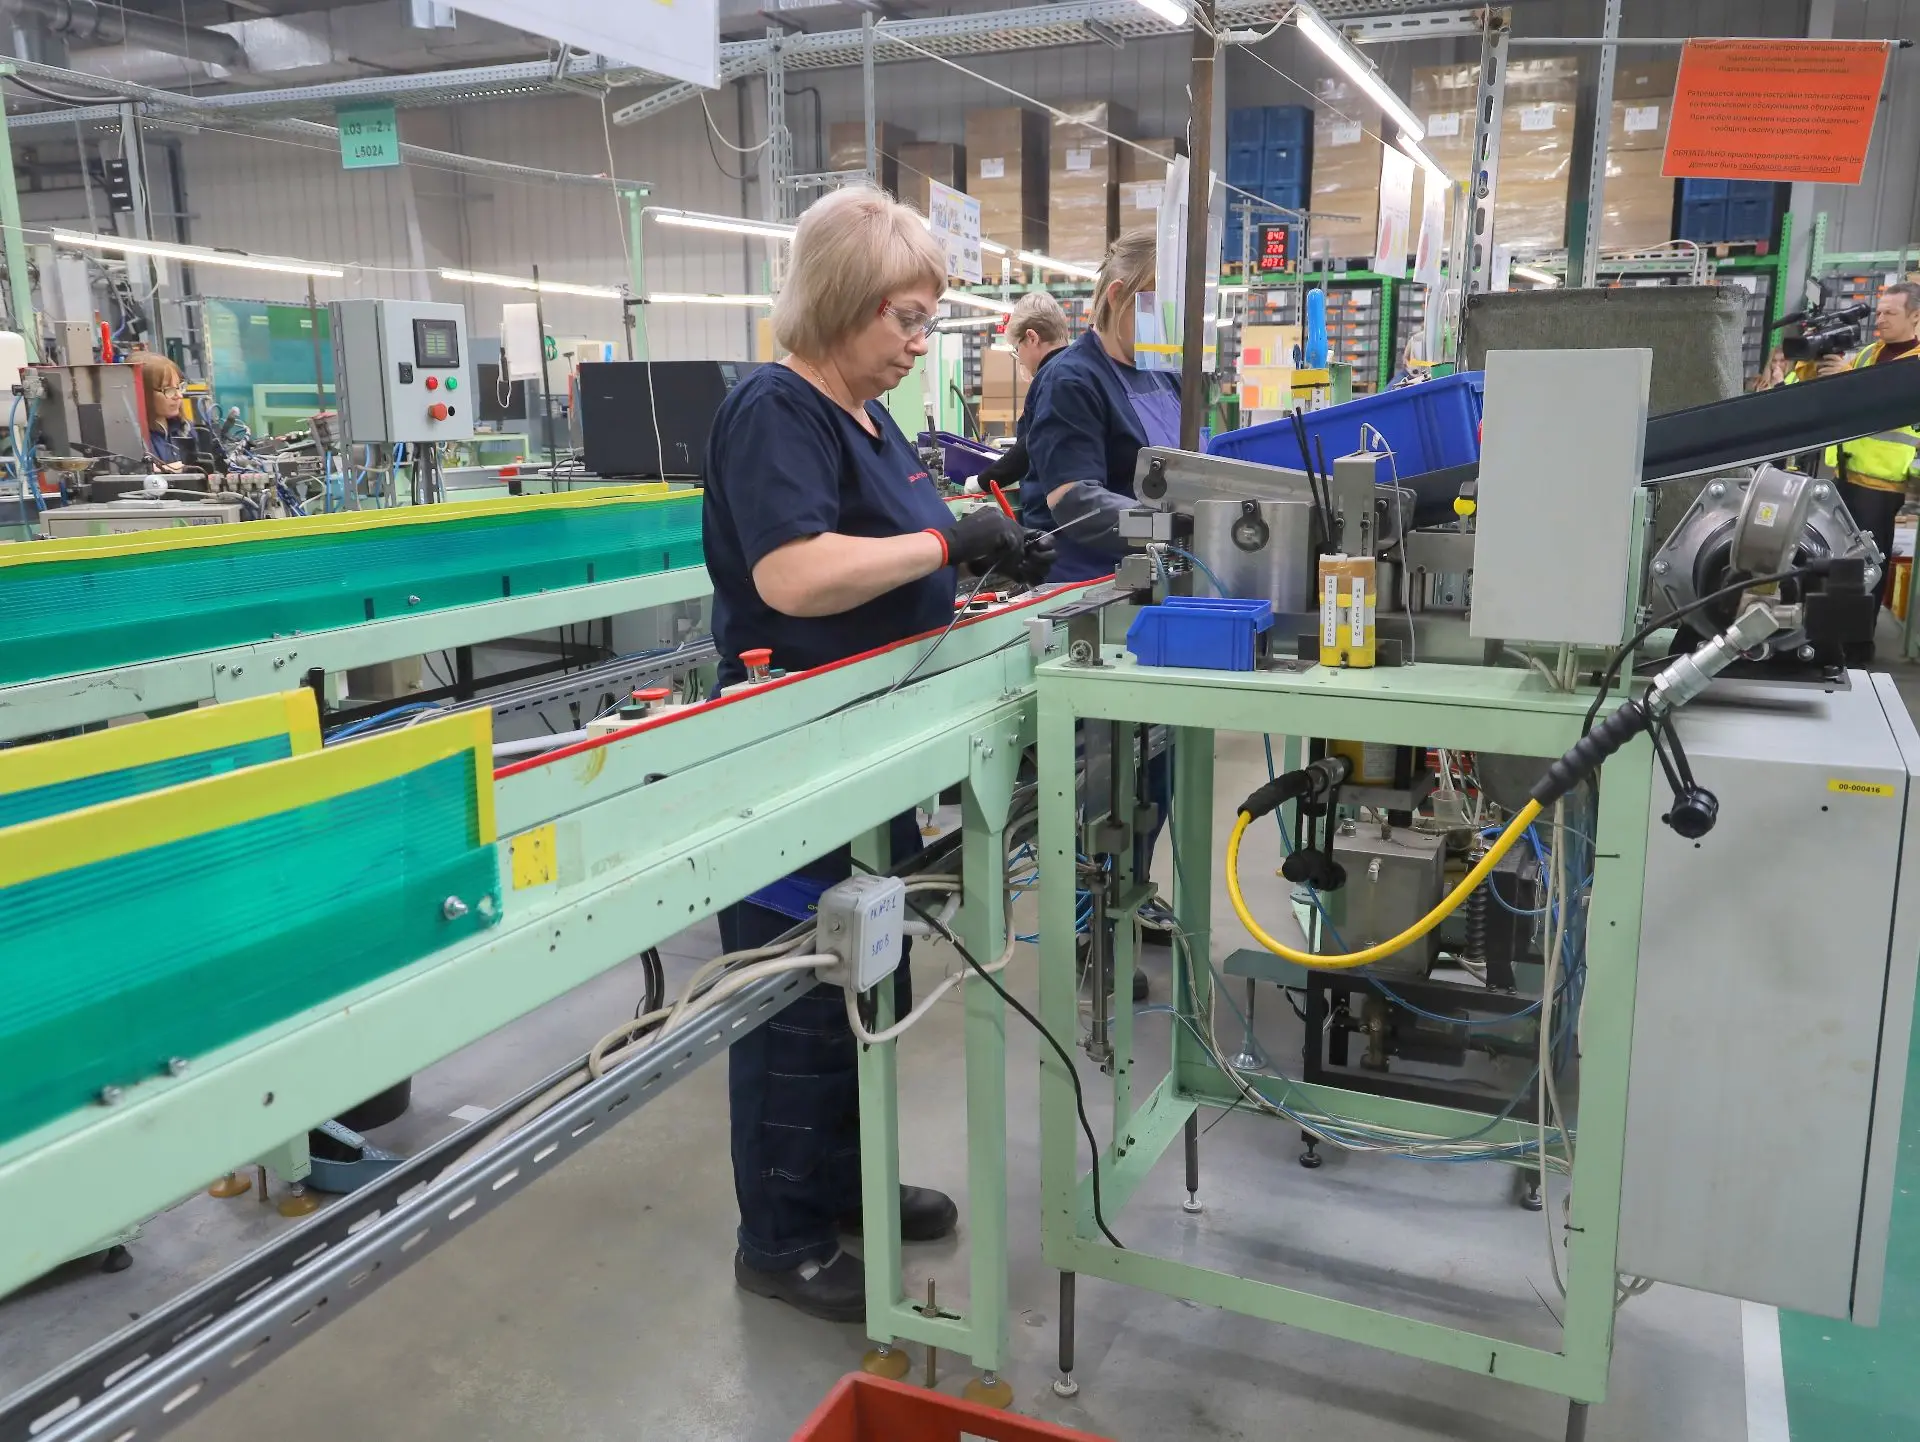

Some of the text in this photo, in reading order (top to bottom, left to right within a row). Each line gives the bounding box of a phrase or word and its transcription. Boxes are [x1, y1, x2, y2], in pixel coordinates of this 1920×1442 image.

[355, 144, 384, 158] L502A
[1673, 149, 1727, 157] ОБЯЗАТЕЛЬНО
[1838, 783, 1881, 794] 00-000416
